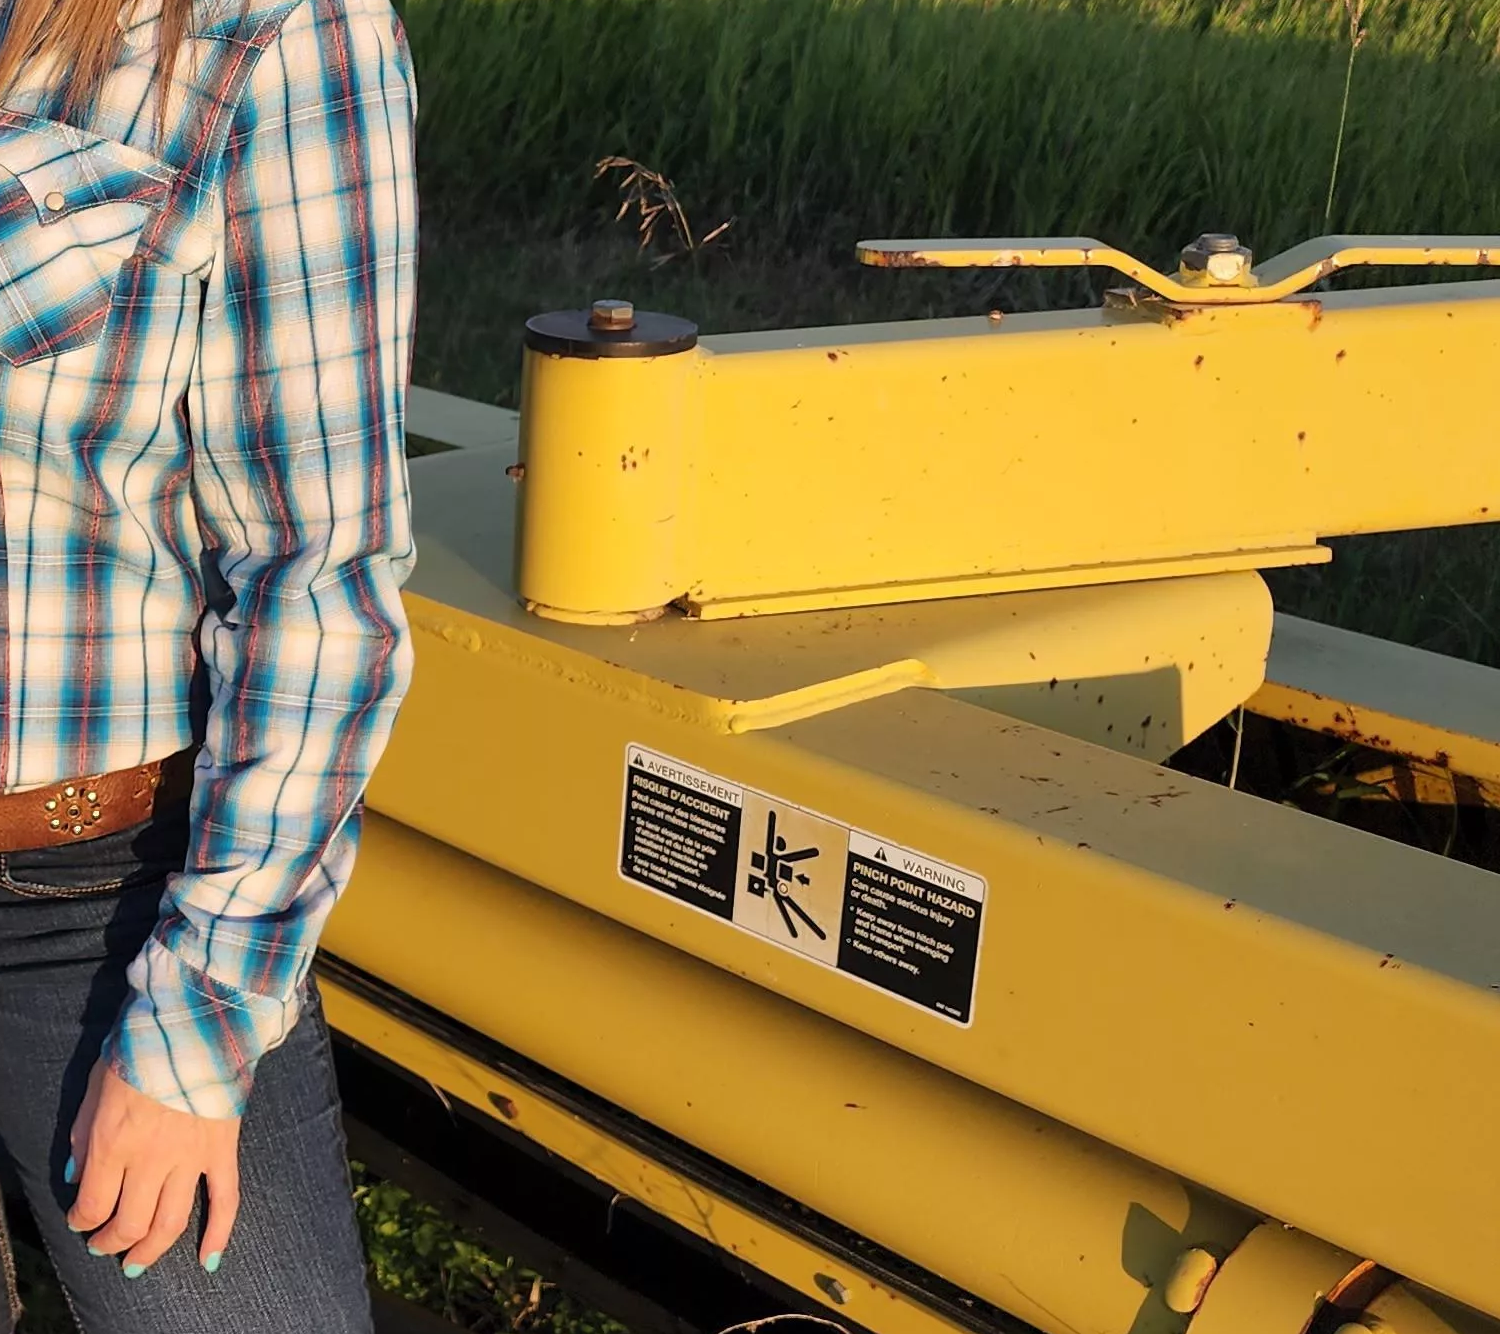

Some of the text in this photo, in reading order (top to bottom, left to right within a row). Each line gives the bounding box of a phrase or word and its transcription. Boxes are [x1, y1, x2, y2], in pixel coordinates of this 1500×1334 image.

[633, 774, 730, 821] RISQUE D'ACCIDENT
[647, 760, 739, 803] AVERTISSEMENT
[852, 861, 976, 919] PINCH POINT HAZARD
[902, 859, 965, 892] WARNING
[850, 890, 887, 910] or death.
[851, 877, 954, 928] Can cause serious injury
[855, 907, 954, 955] Keep away from hitch pole
[852, 939, 920, 976] Keep others away.
